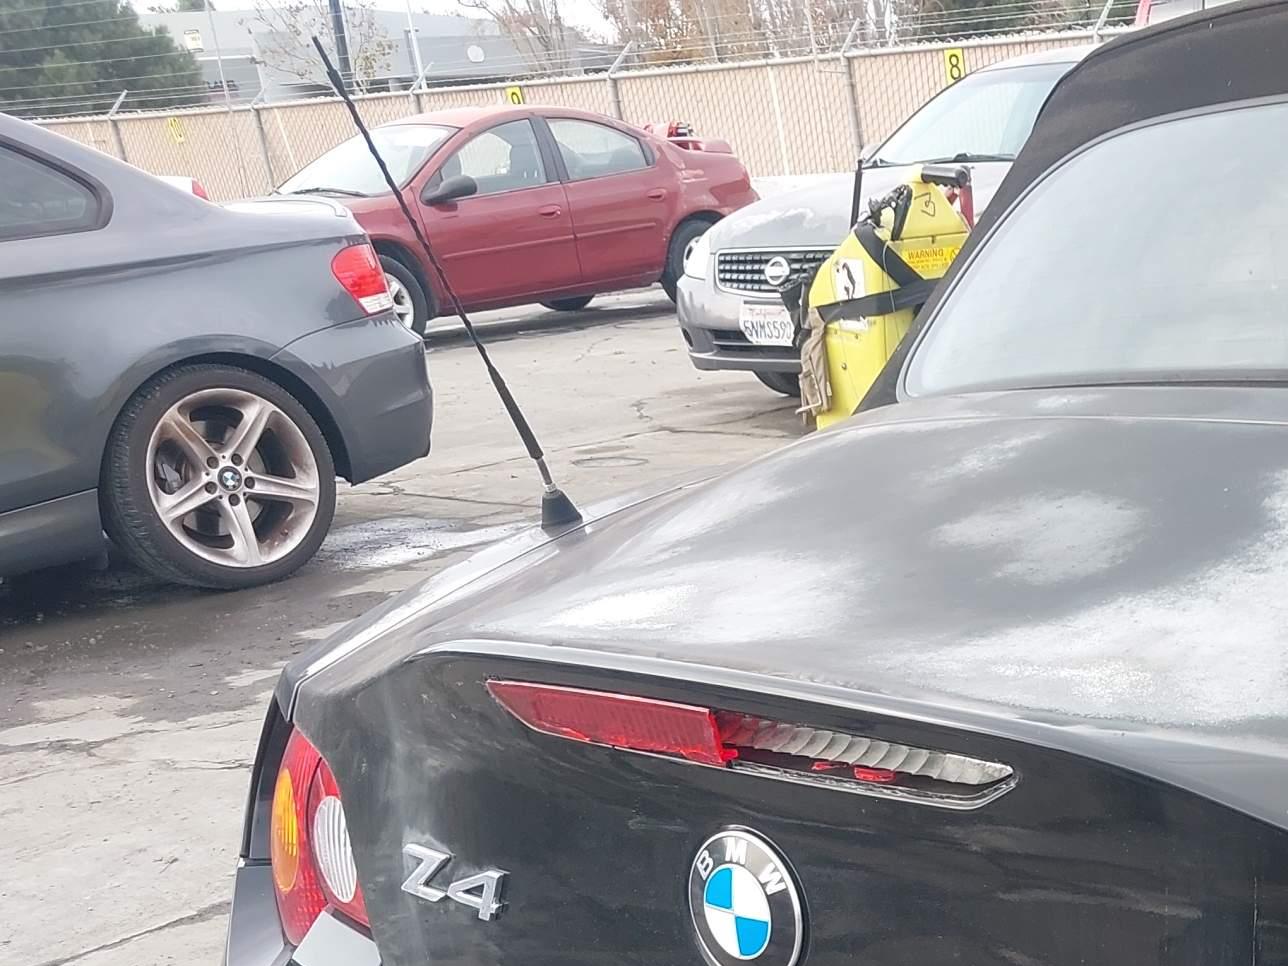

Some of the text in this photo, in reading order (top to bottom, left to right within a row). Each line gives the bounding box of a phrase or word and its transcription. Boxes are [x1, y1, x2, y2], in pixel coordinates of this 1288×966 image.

[949, 54, 961, 80] 8
[907, 248, 944, 260] WARNING
[401, 842, 509, 922] Z4
[697, 836, 787, 896] BMW
